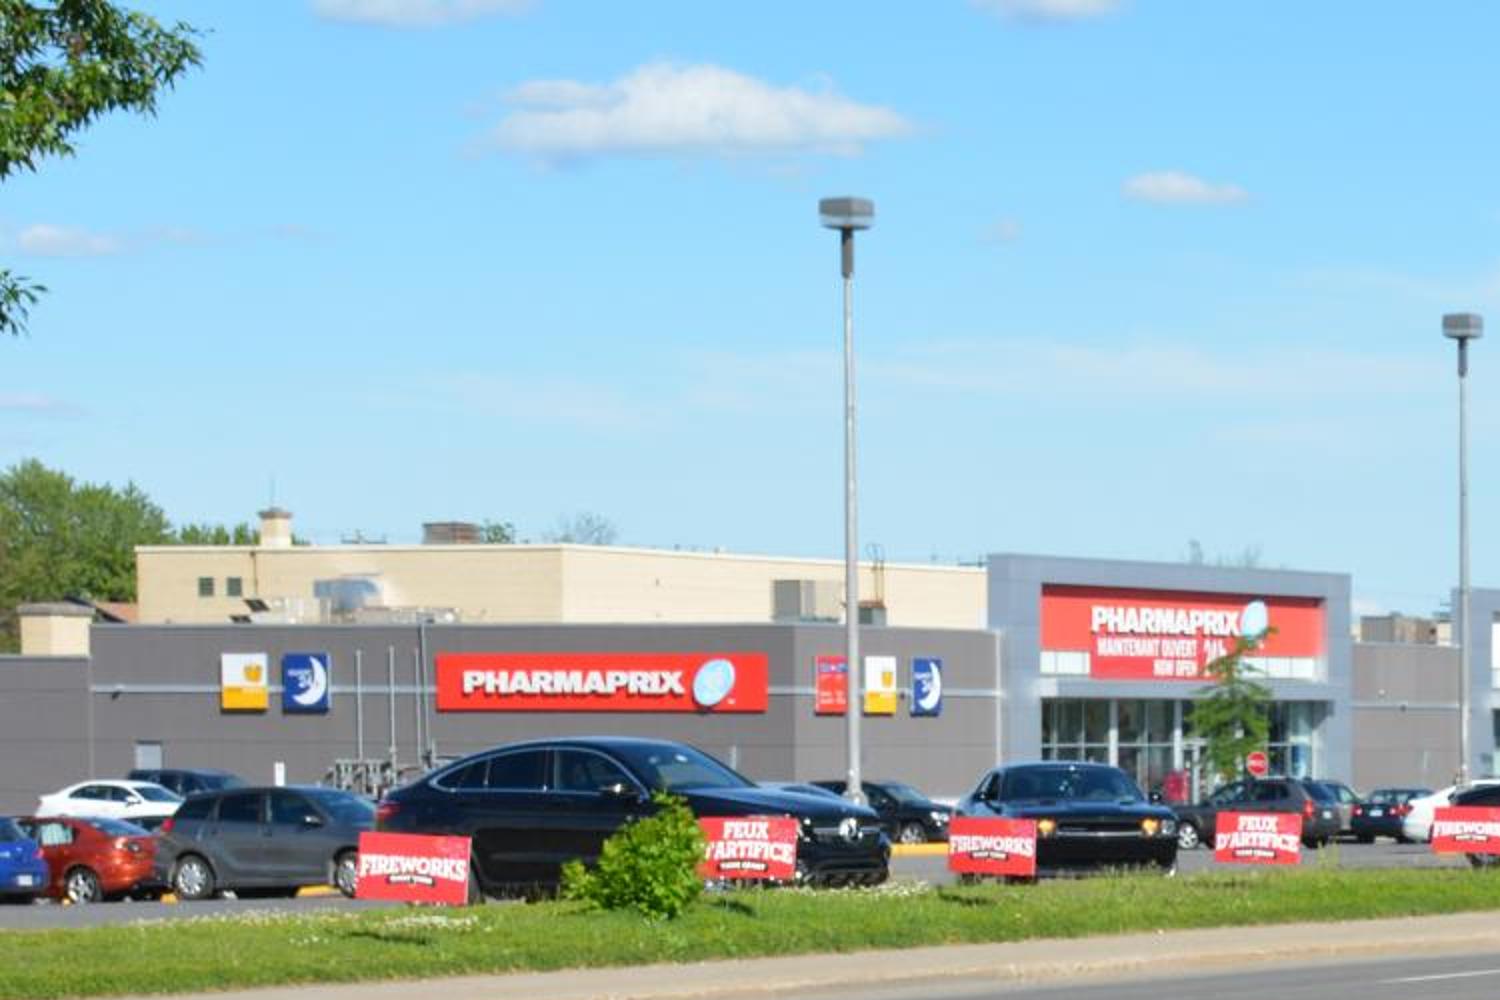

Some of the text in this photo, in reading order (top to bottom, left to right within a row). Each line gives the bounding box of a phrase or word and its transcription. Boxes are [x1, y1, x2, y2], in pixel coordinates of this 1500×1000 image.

[1090, 605, 1242, 637] PHARMAPRIX
[462, 670, 685, 694] PHARMAPRIX
[723, 821, 769, 840] FEUX
[1237, 815, 1279, 832] FEUX
[704, 840, 794, 865] 'ARTIFICE
[949, 835, 1034, 858] FIREWORKS
[1216, 831, 1301, 853] D'ARTIFICE
[359, 853, 467, 883] FIREWORKS
